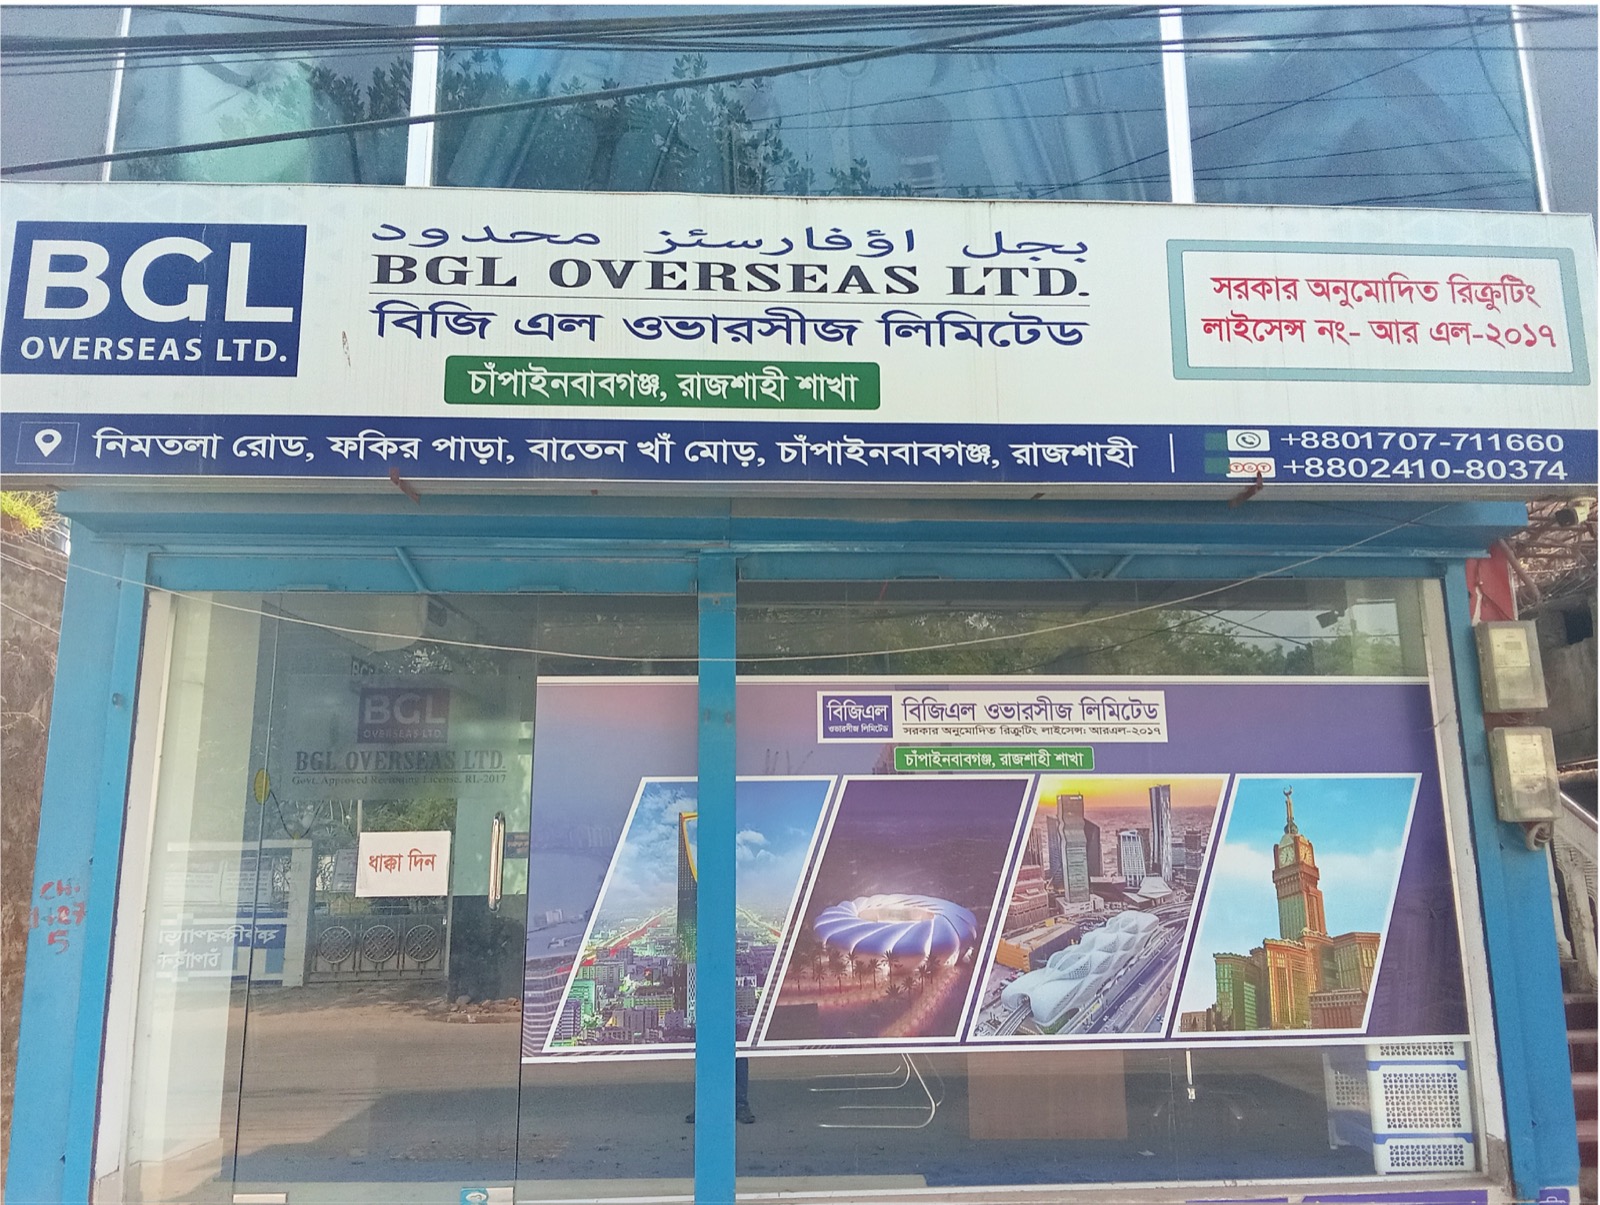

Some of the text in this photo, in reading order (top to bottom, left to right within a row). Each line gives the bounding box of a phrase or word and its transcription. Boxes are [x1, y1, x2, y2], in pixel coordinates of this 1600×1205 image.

[372, 224, 600, 248] محدود
[963, 231, 1087, 262] بجل
[23, 237, 293, 322] BGL
[372, 255, 1089, 296] BGL OVERSEAS LTD.
[1210, 277, 1299, 301] সরকার
[1306, 272, 1439, 306] অনুমোদিত
[369, 300, 1089, 347] বিজি এল ওভারসীজ লিমিটেড
[1201, 310, 1306, 343] লাইসেন্স
[1368, 320, 1420, 344] আর
[1430, 322, 1556, 348] এল-২০১৭
[21, 337, 286, 362] OVERSEAS LTD.
[467, 361, 859, 402] চাঁপাইনবাবগঞ্জ, রাজশাহী শাখা
[92, 427, 1138, 468] নিমতলা রোড, ফকির পাড়া, বাতেন খাঁ মোড়, চাঁপাইনবাবগঞ্জ, রাজশাহী
[1281, 431, 1565, 453] +8801707-711660
[1283, 457, 1568, 480] +8802410-80374
[364, 692, 446, 724] BGL
[825, 698, 889, 721] বিজিএল
[901, 695, 1159, 721] বিজিএল ওভারসীজ লিমিটেড
[363, 729, 420, 738] OVERSEAS
[903, 726, 940, 735] সরকার
[294, 750, 506, 771] BGL OVERSEAS LTD.
[999, 748, 1052, 769] রাজশাহী
[1054, 752, 1085, 768] শাখা
[368, 853, 404, 873] ধাক্কা
[407, 848, 437, 872] দিন
